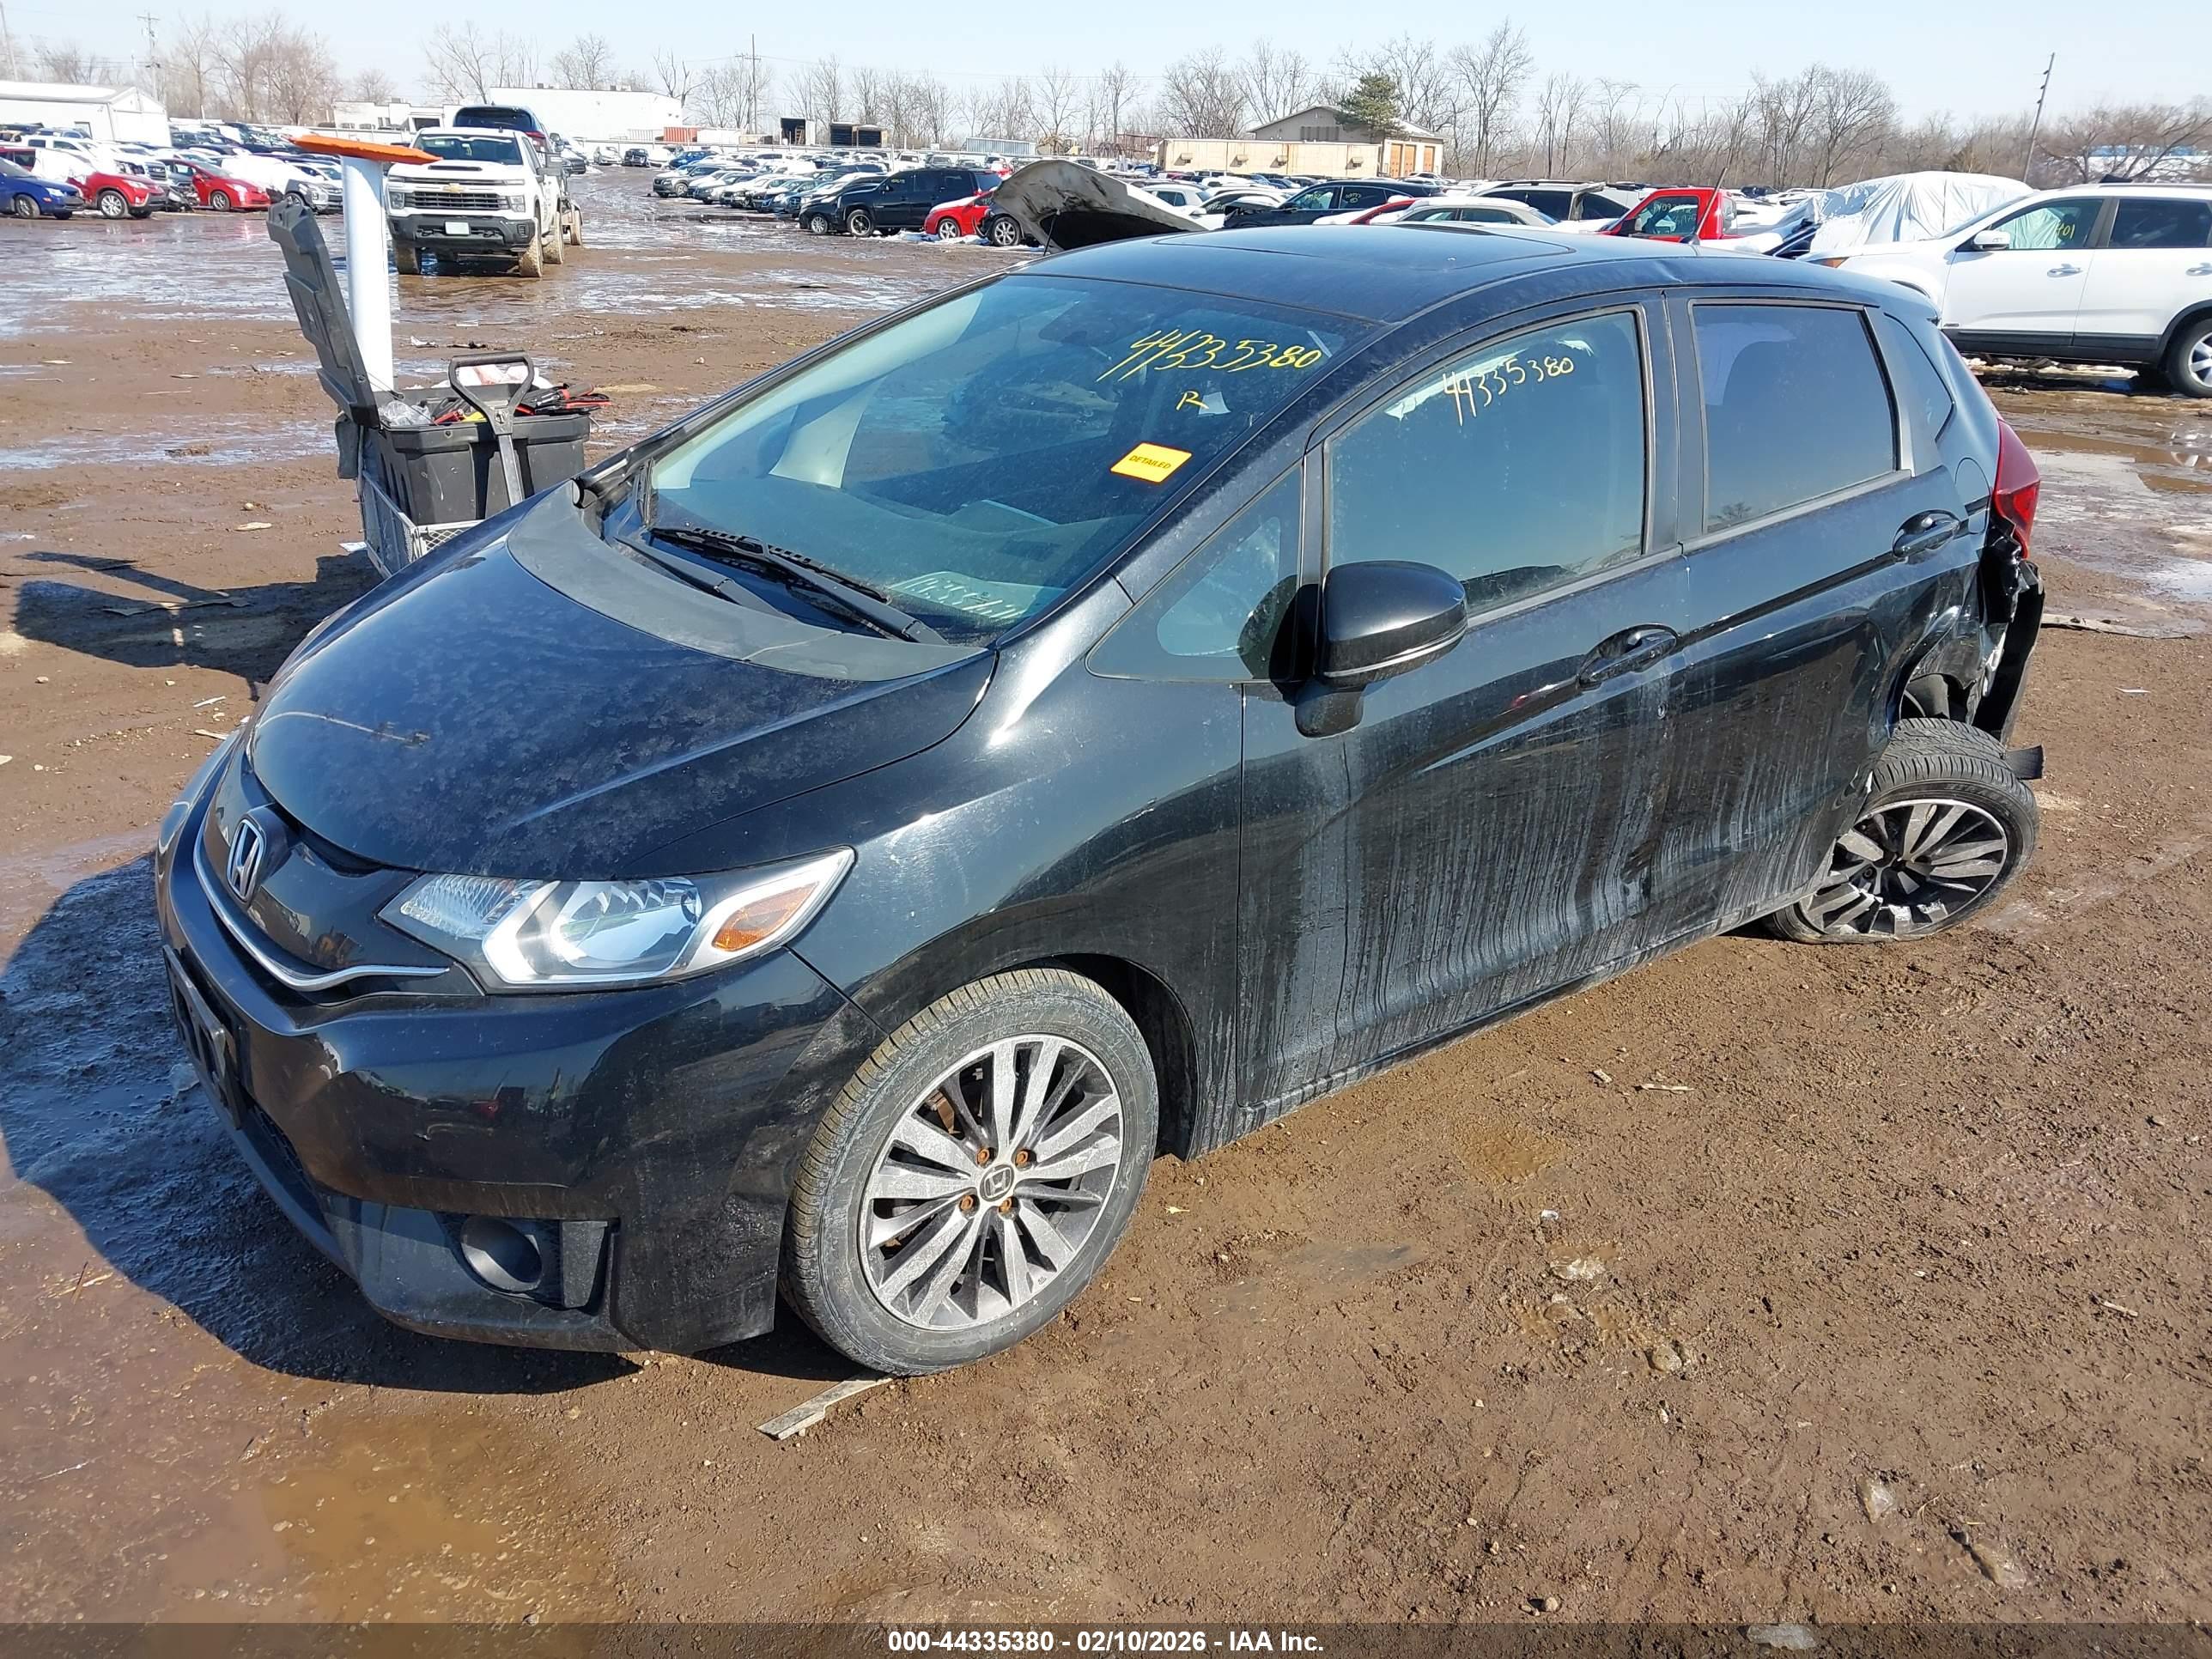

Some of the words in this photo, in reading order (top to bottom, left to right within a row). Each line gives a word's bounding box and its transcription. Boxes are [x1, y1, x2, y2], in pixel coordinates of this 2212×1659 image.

[1095, 329, 1322, 383] 44335380
[1176, 391, 1210, 411] R
[1442, 356, 1574, 427] 44335380
[1128, 455, 1171, 470] DETAILED
